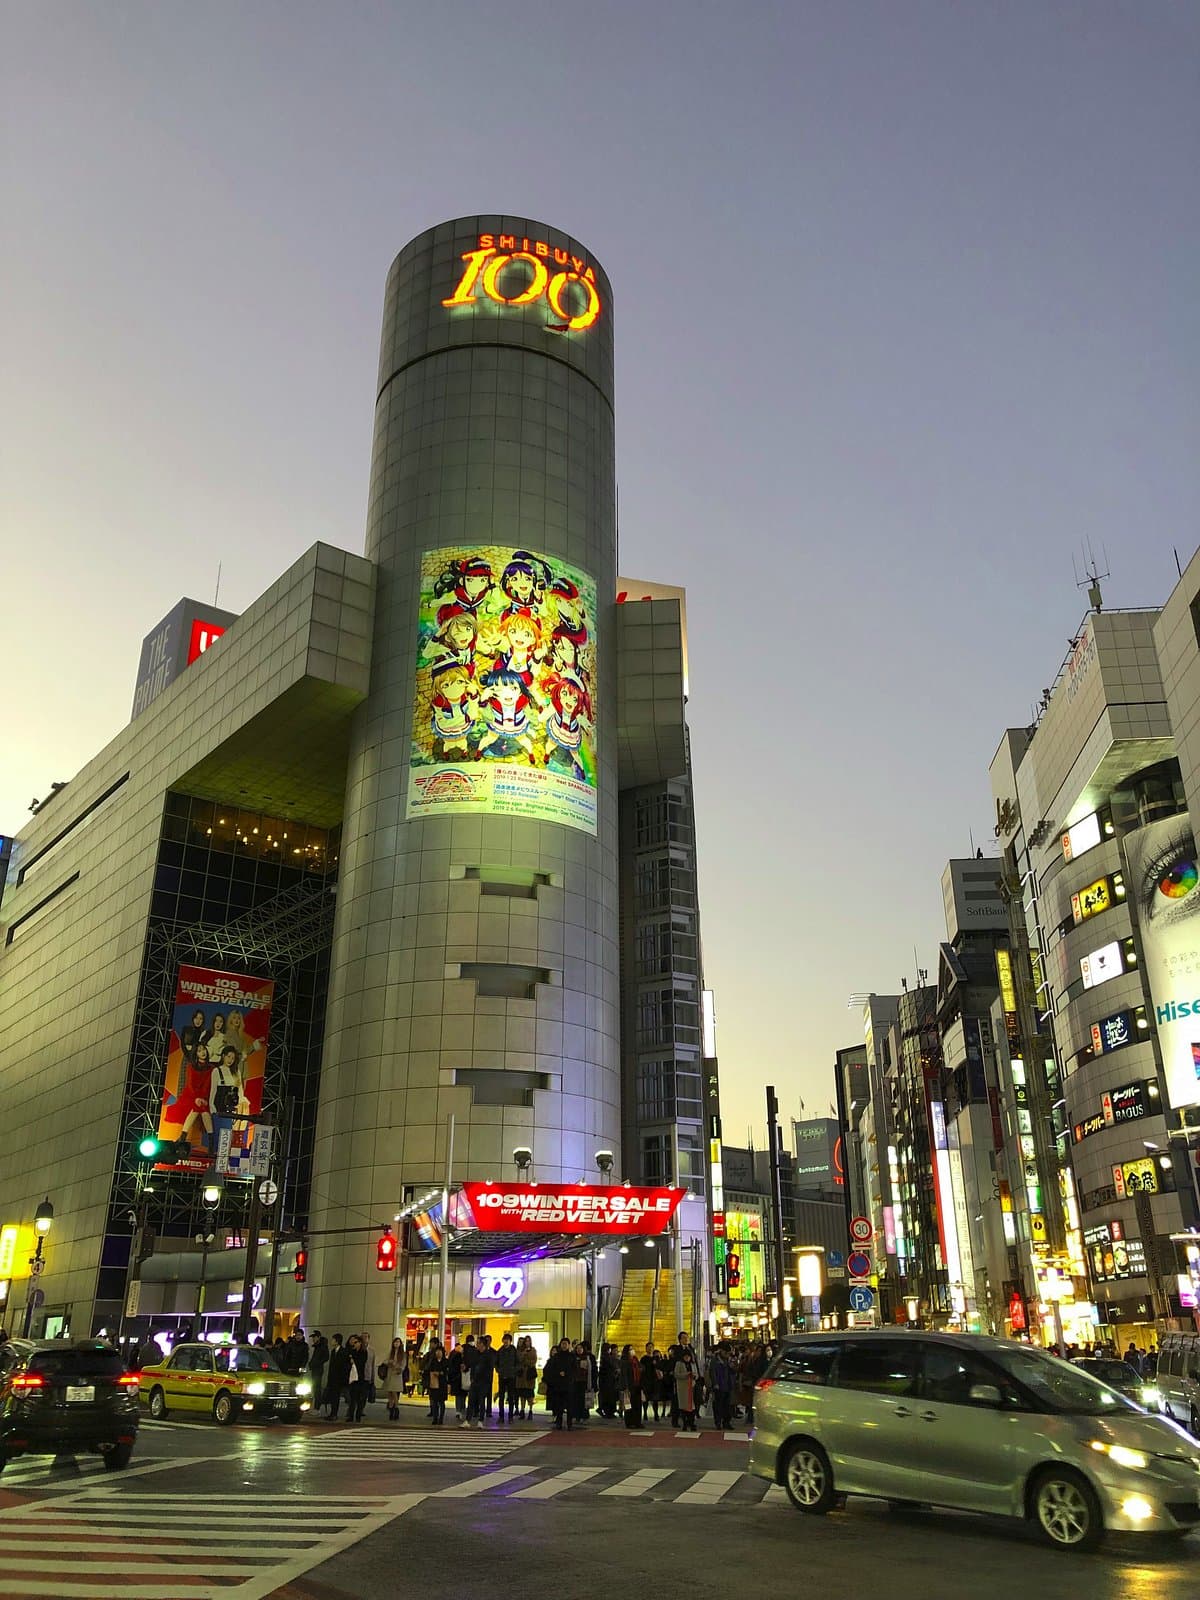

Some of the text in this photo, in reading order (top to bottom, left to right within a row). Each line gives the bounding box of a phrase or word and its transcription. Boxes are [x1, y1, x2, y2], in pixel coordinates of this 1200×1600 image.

[479, 234, 596, 283] SHIBUYA
[441, 247, 602, 332] 109
[967, 905, 1008, 917] SoftBank
[214, 978, 240, 990] 109
[609, 1196, 671, 1212] SALE
[520, 1208, 566, 1222] RED
[565, 1210, 645, 1224] VELVET
[855, 1223, 868, 1235] 30
[476, 1278, 524, 1307] 109
[855, 1293, 865, 1309] P
